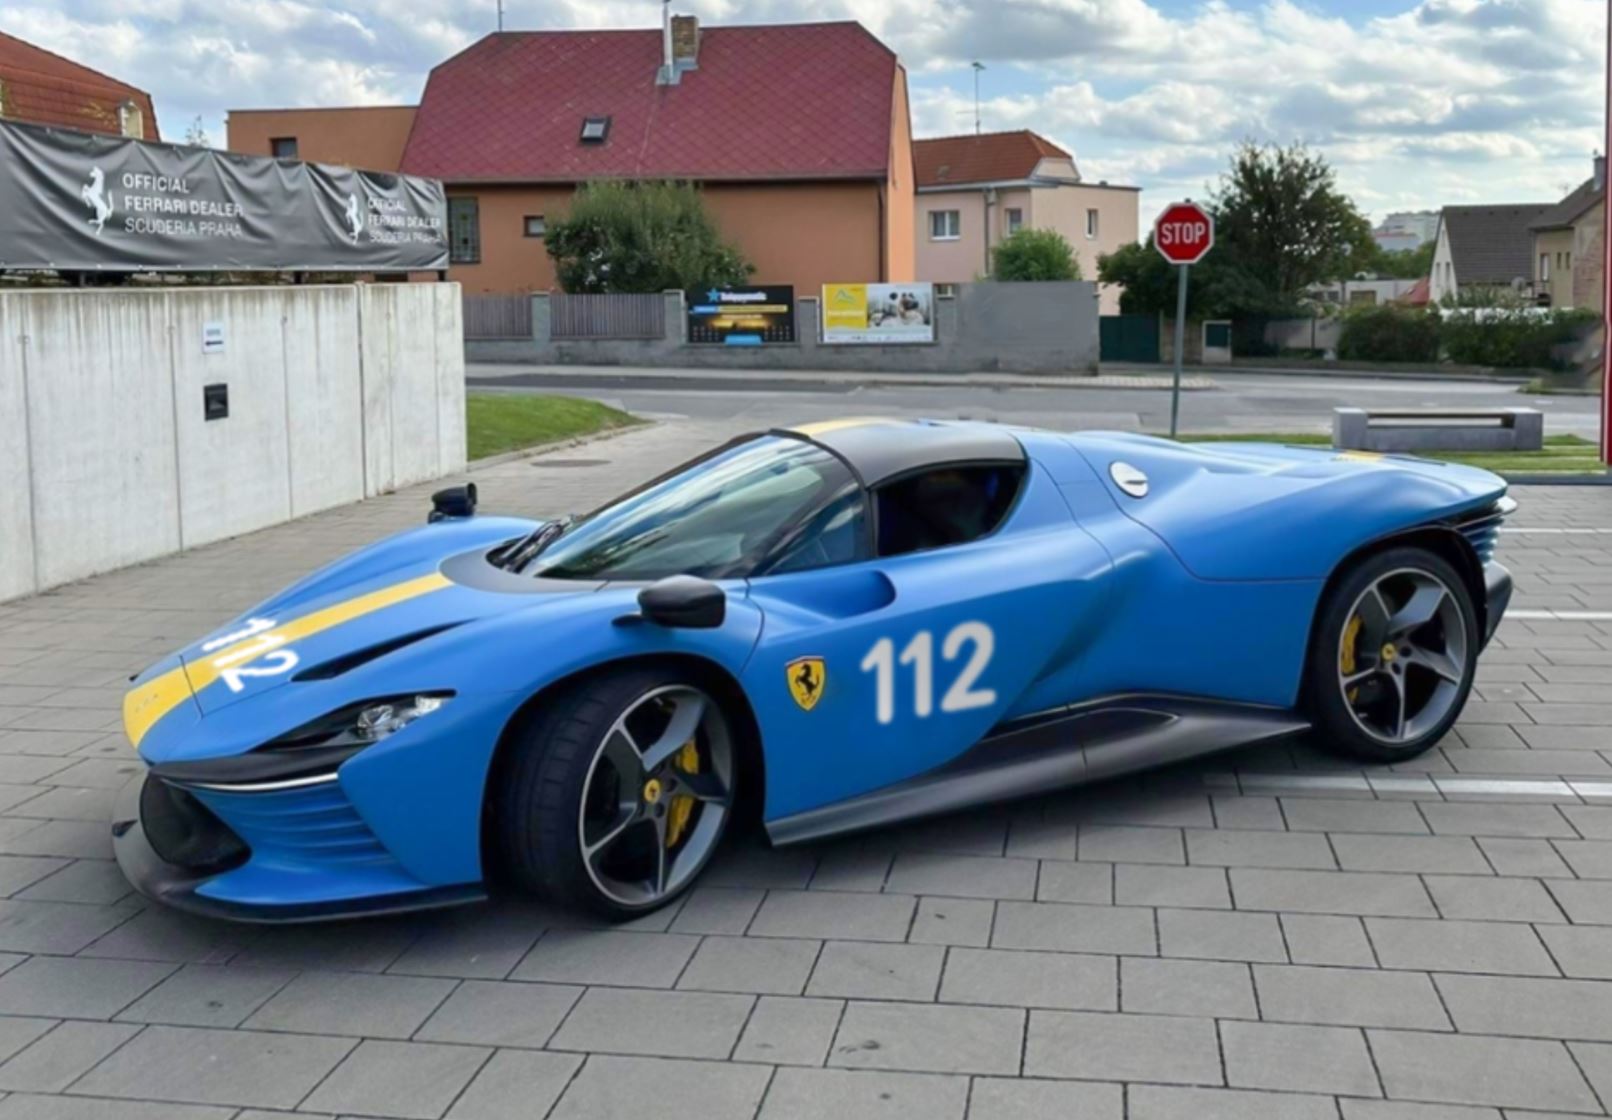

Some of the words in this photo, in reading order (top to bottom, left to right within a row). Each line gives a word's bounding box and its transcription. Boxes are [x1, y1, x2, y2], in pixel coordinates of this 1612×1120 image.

[122, 173, 190, 194] OFFICIAL
[124, 195, 188, 214] FERRARI
[189, 200, 243, 217] DEALER
[124, 217, 197, 235] SCUDERIA
[199, 221, 242, 237] PRAHA
[1161, 222, 1206, 245] STOP
[202, 617, 299, 693] 112
[861, 620, 997, 725] 112
